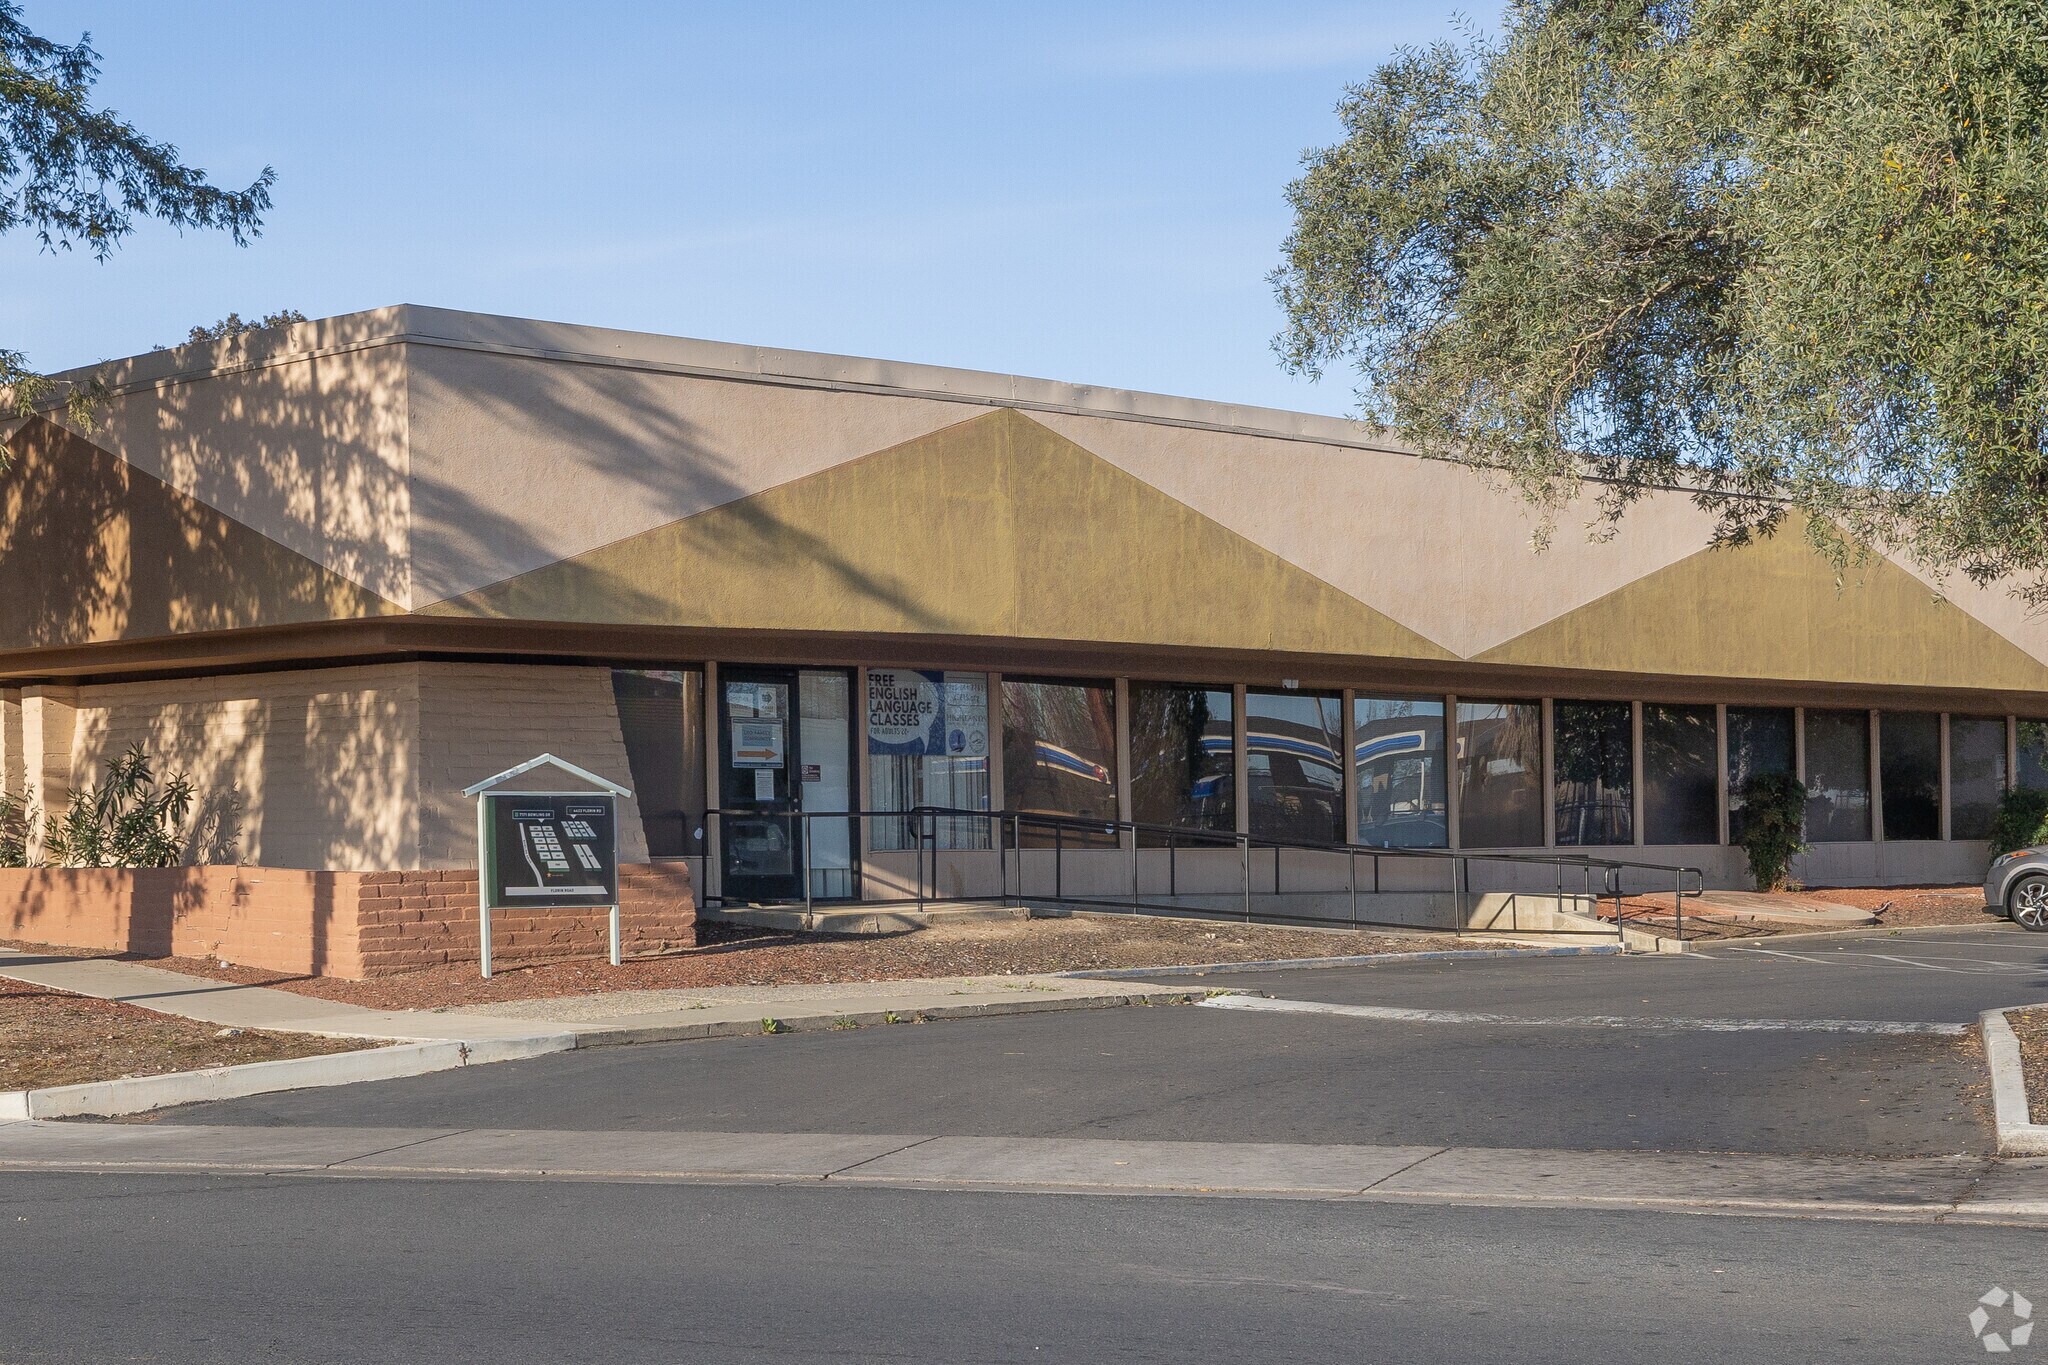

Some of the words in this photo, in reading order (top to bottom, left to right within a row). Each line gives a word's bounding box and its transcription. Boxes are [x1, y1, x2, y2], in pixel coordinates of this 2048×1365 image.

[868, 674, 895, 687] FREE
[869, 687, 918, 700] ENGLISH
[869, 700, 933, 714] LANGUAGE
[870, 713, 920, 726] CLASSES
[870, 727, 880, 735] FOR
[881, 727, 900, 735] ADULTS
